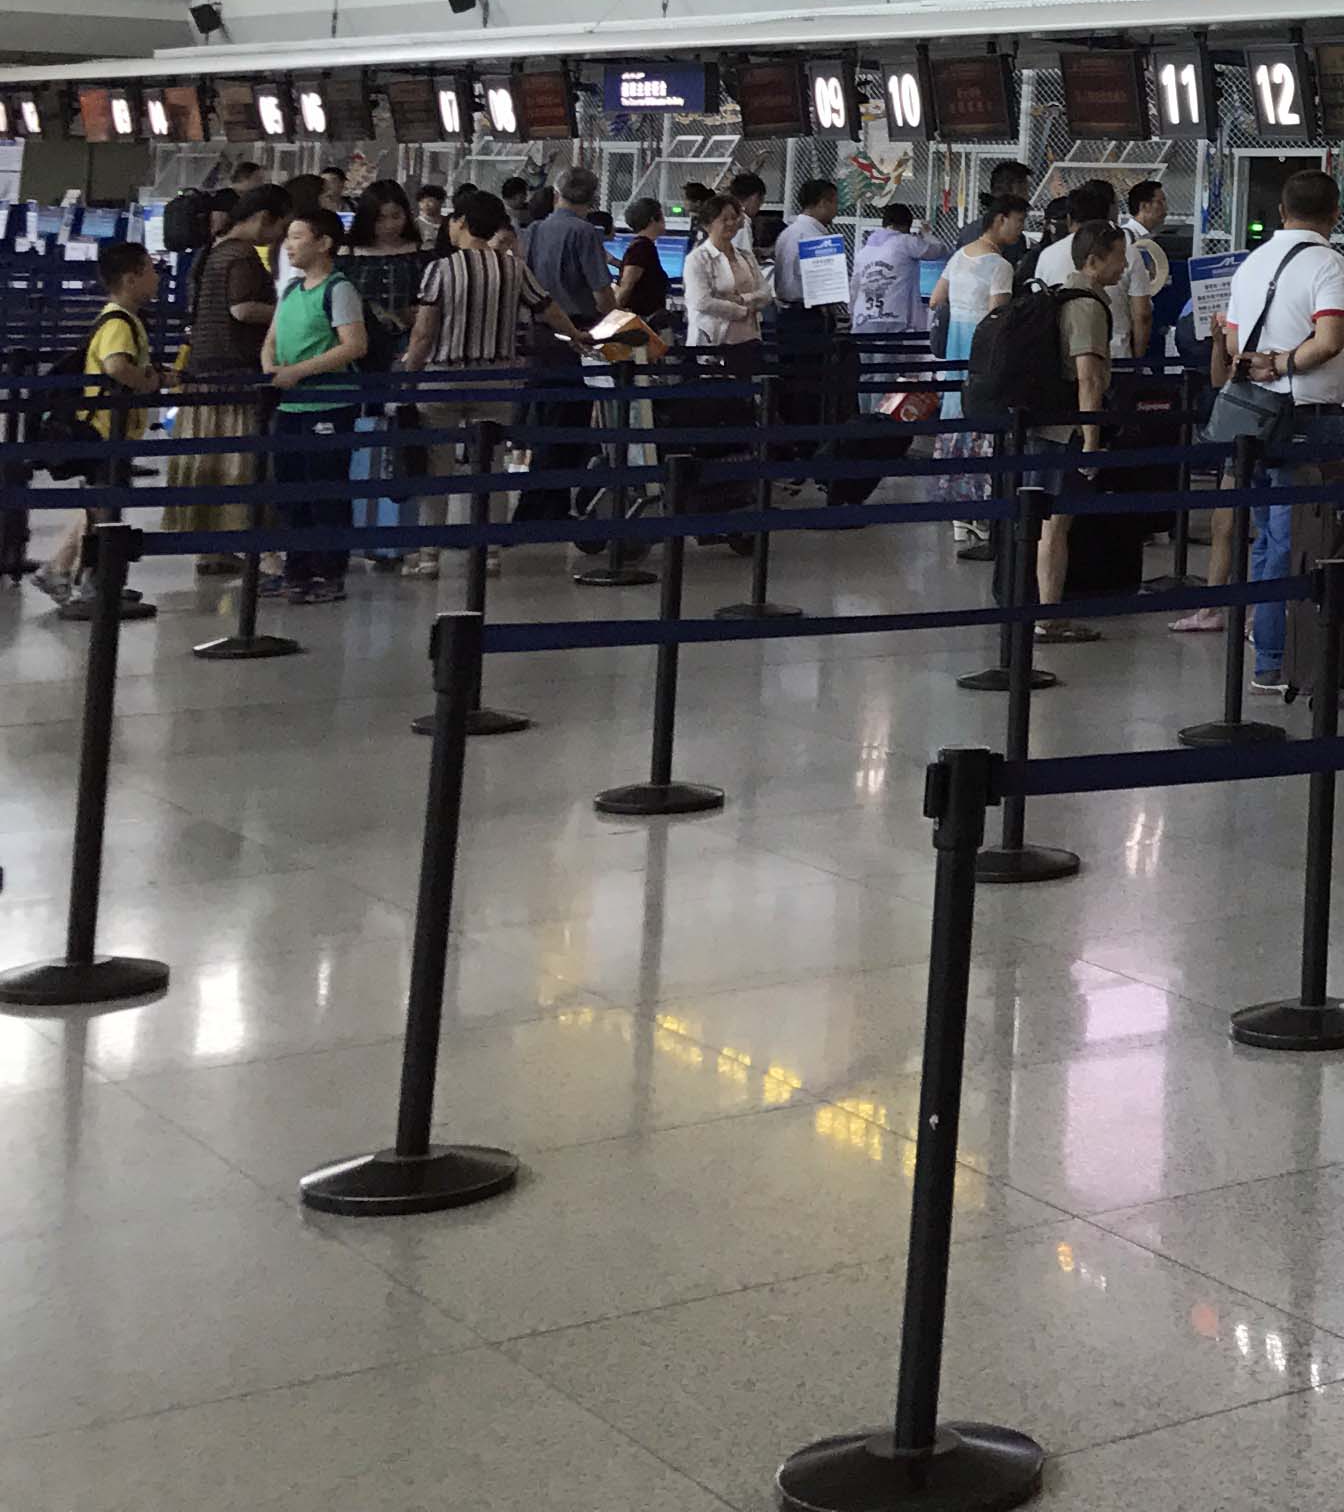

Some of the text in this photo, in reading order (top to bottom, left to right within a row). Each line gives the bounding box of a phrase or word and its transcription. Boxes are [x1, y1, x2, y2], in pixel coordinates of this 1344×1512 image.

[814, 76, 847, 129] 09
[888, 73, 921, 128] 10
[1161, 63, 1200, 126] 11
[1255, 62, 1300, 126] 12
